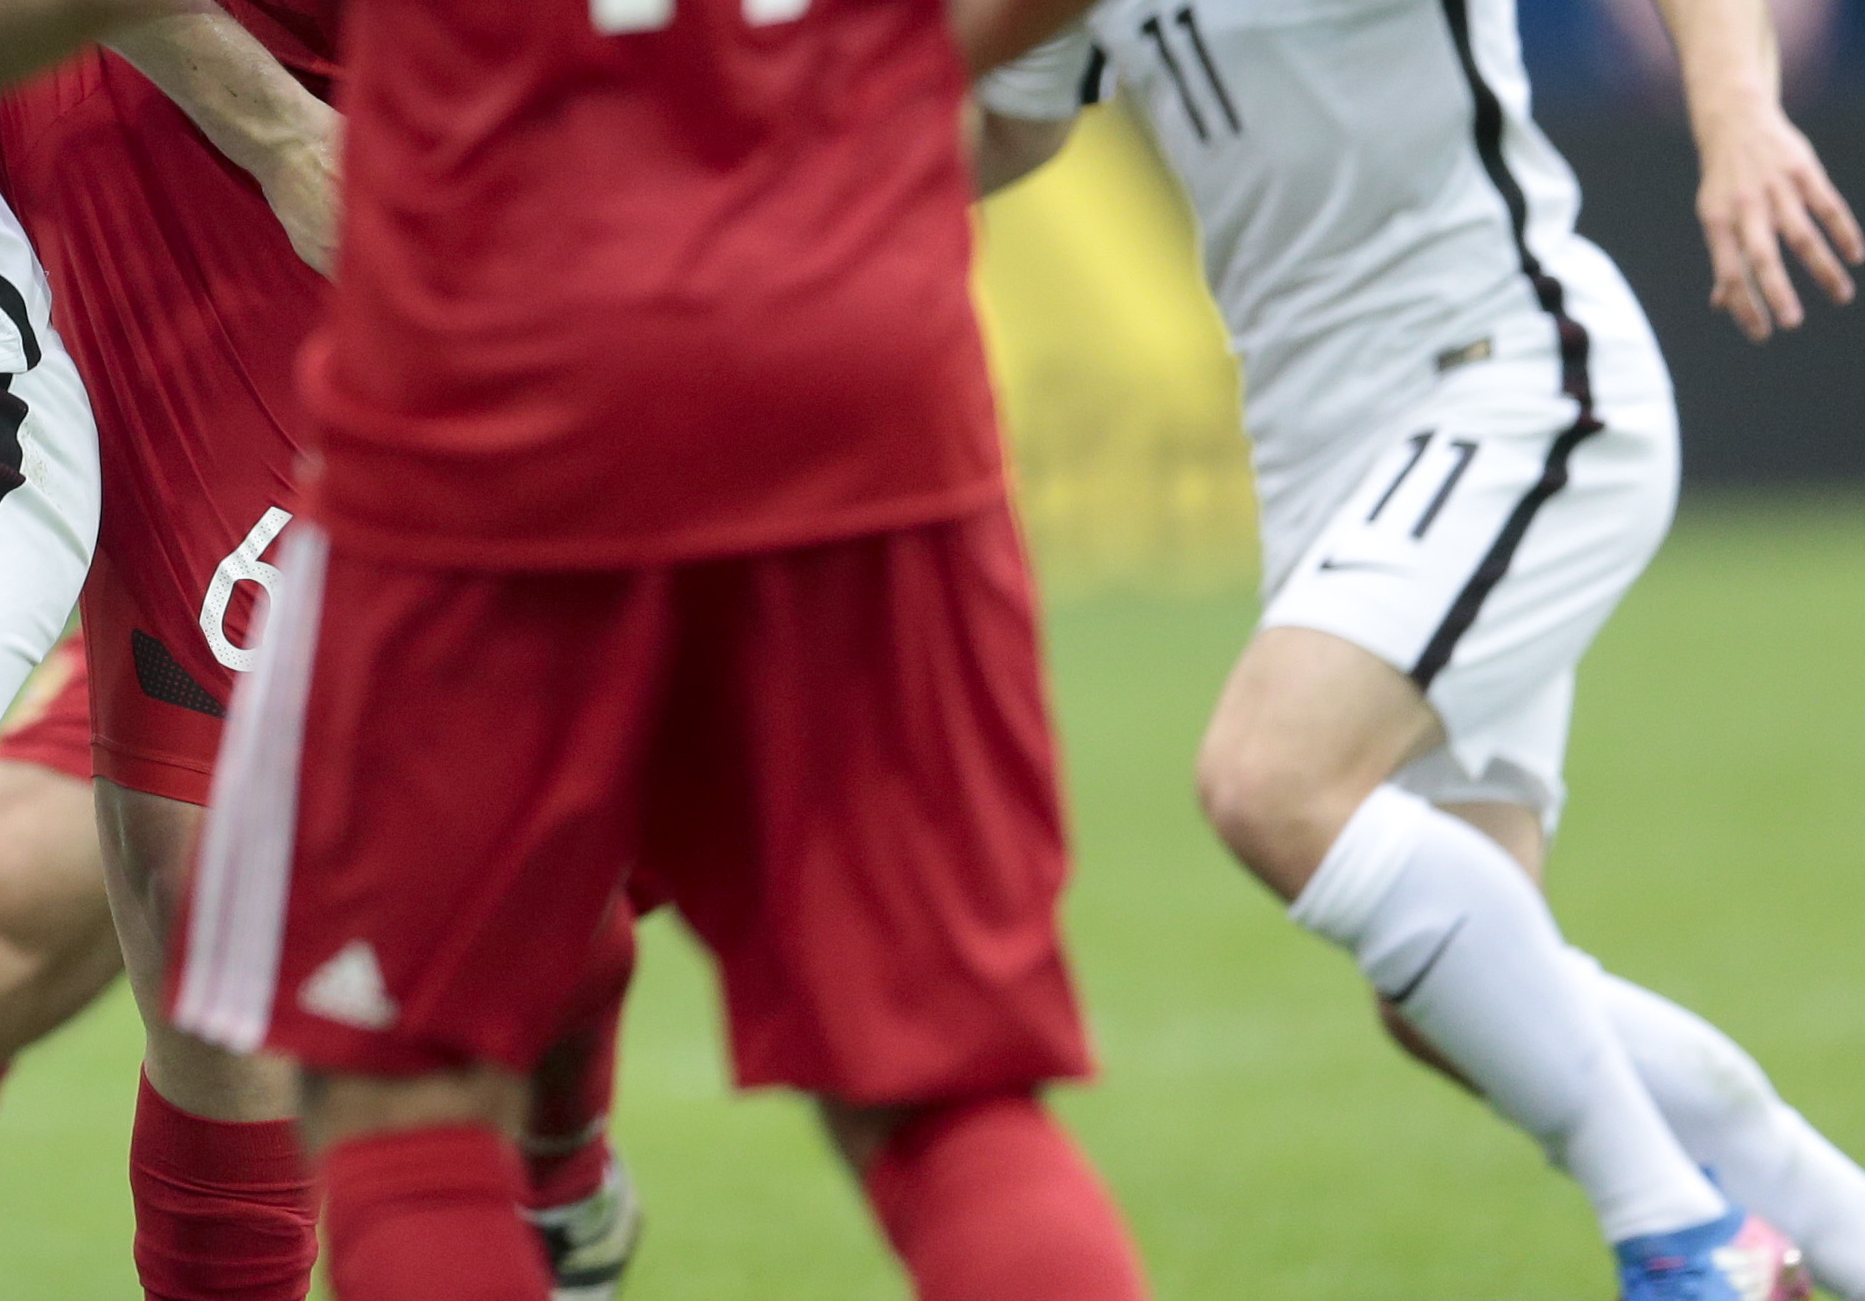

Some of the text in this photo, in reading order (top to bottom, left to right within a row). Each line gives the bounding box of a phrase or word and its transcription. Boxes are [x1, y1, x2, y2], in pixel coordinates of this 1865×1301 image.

[1140, 4, 1244, 145] 11
[1364, 429, 1481, 540] 11
[198, 505, 294, 673] 6
